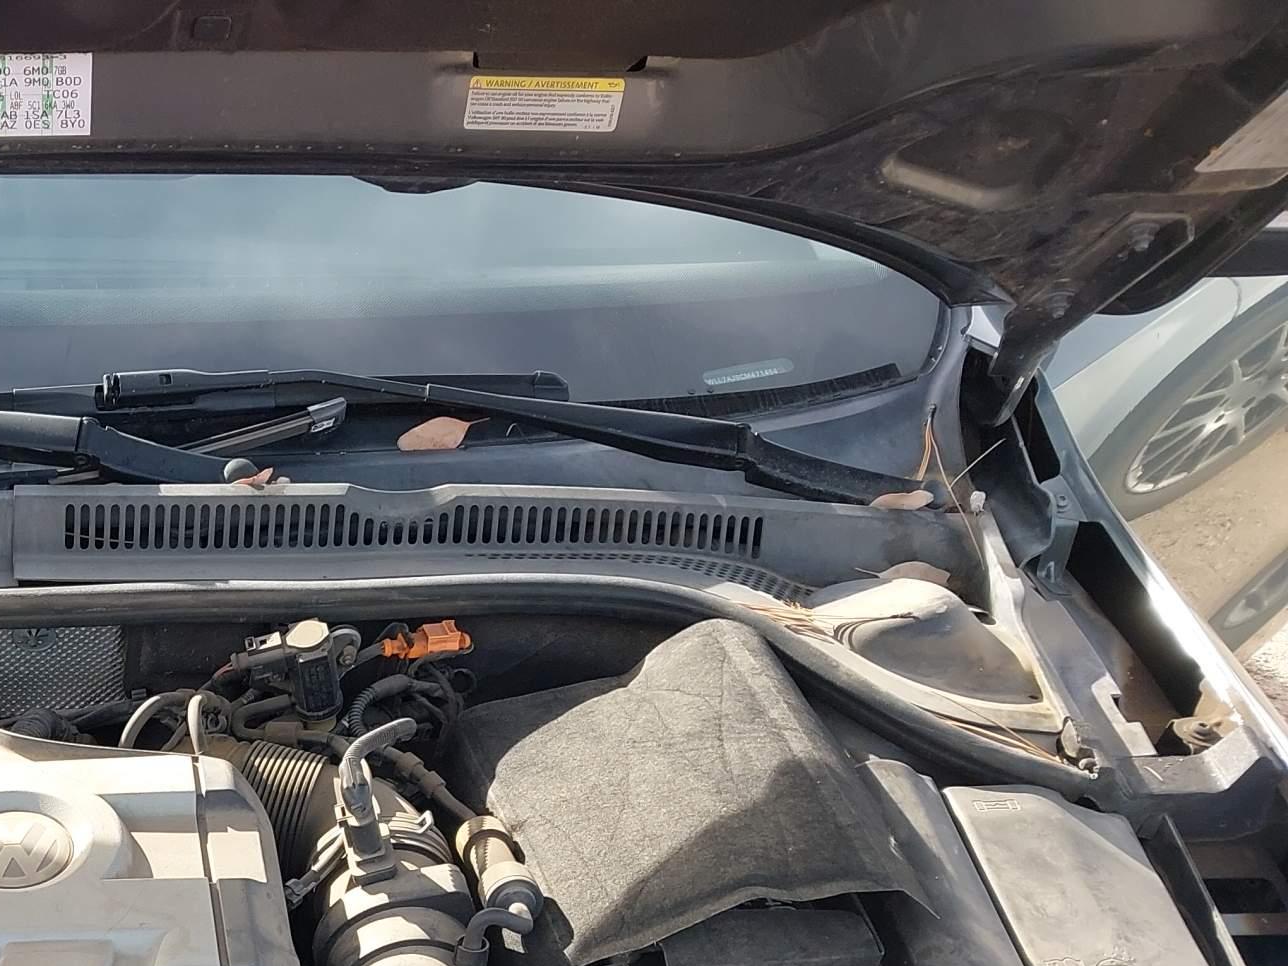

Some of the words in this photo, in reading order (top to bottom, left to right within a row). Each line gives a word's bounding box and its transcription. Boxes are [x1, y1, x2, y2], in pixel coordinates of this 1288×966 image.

[23, 66, 49, 76] 6M0
[485, 80, 526, 89] WARNING
[534, 81, 600, 90] AVERTISSEMENT
[43, 89, 79, 99] TC06
[23, 110, 49, 120] 1SA
[55, 109, 81, 119] 7L3
[60, 119, 86, 129] 8Y0
